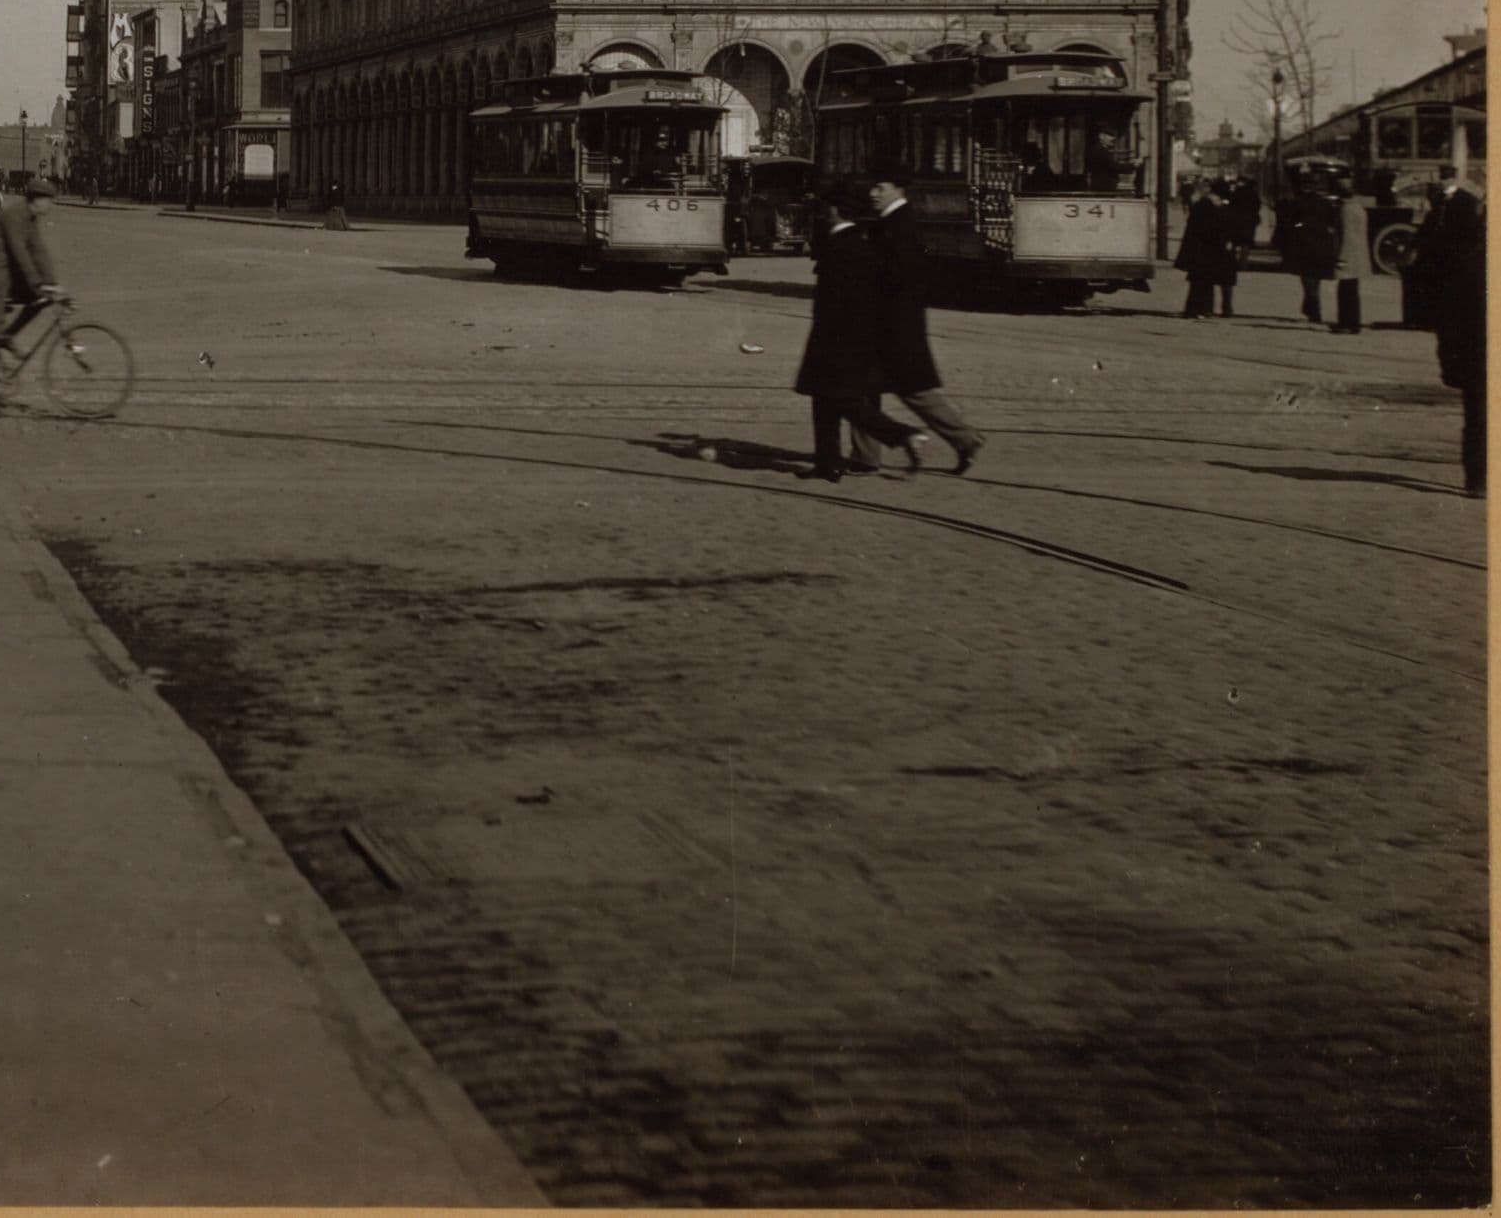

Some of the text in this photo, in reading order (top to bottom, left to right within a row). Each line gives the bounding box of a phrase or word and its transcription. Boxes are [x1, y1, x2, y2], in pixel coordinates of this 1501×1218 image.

[143, 65, 156, 134] SIGNS
[646, 199, 700, 212] 406
[1064, 204, 1117, 220] 341
